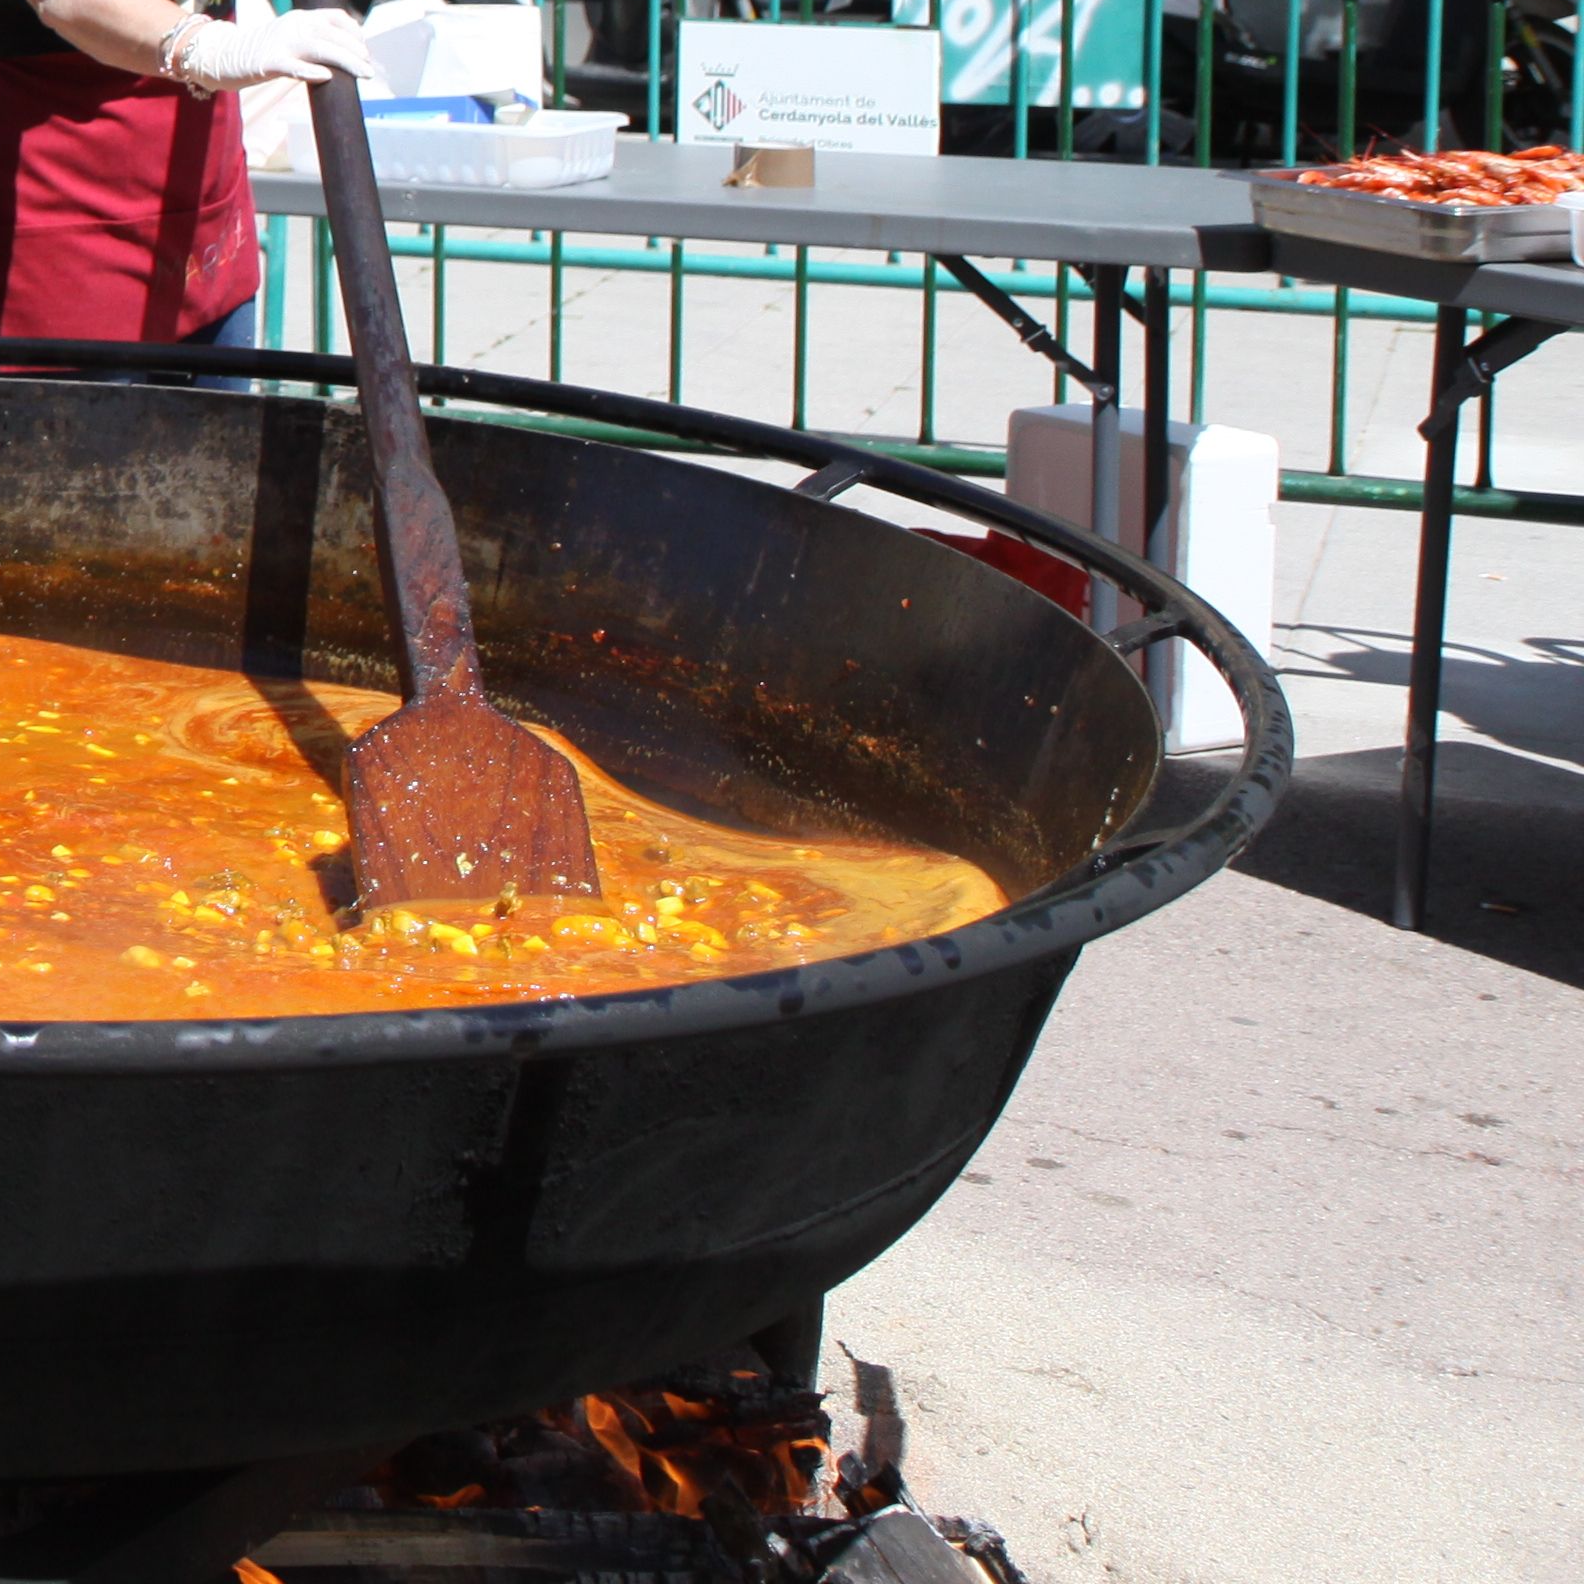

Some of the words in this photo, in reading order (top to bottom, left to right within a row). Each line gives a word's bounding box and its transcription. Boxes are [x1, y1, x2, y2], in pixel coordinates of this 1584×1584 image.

[758, 91, 851, 108] Ajuntament
[855, 95, 877, 109] de
[758, 108, 852, 126] Cerdanyola
[856, 112, 883, 127] del
